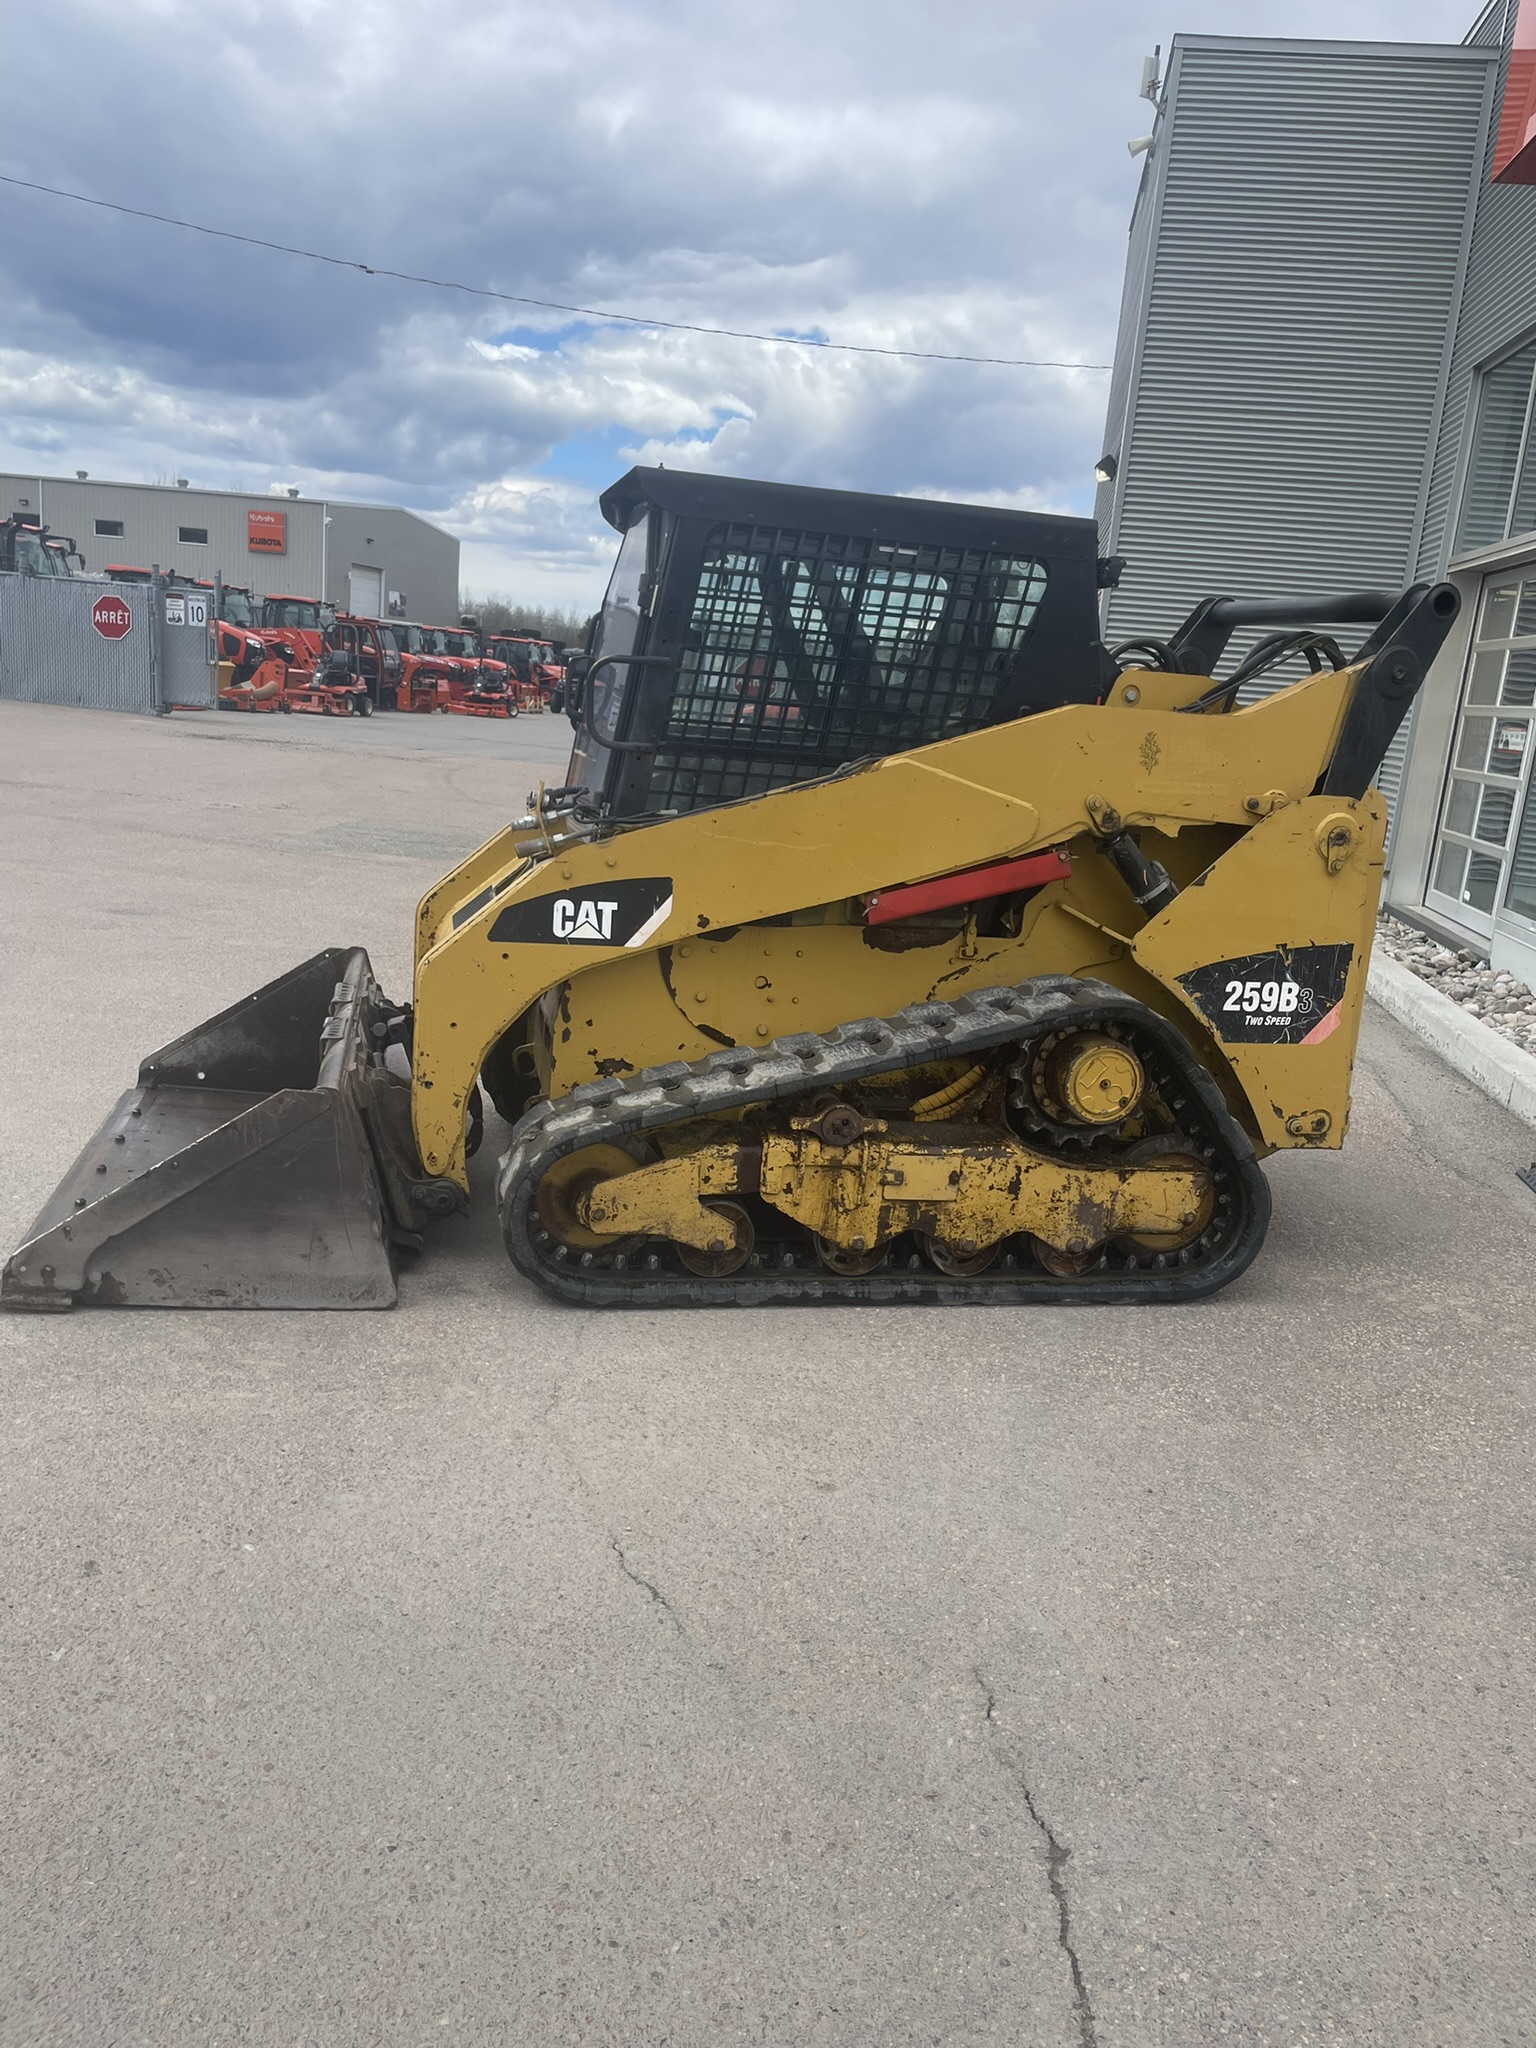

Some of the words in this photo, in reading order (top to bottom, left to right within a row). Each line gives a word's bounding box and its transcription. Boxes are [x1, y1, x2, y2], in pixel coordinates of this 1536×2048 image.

[249, 537, 282, 546] KUBOTA
[94, 609, 129, 625] ARRÊT
[191, 606, 204, 622] 10
[553, 899, 618, 940] CAT
